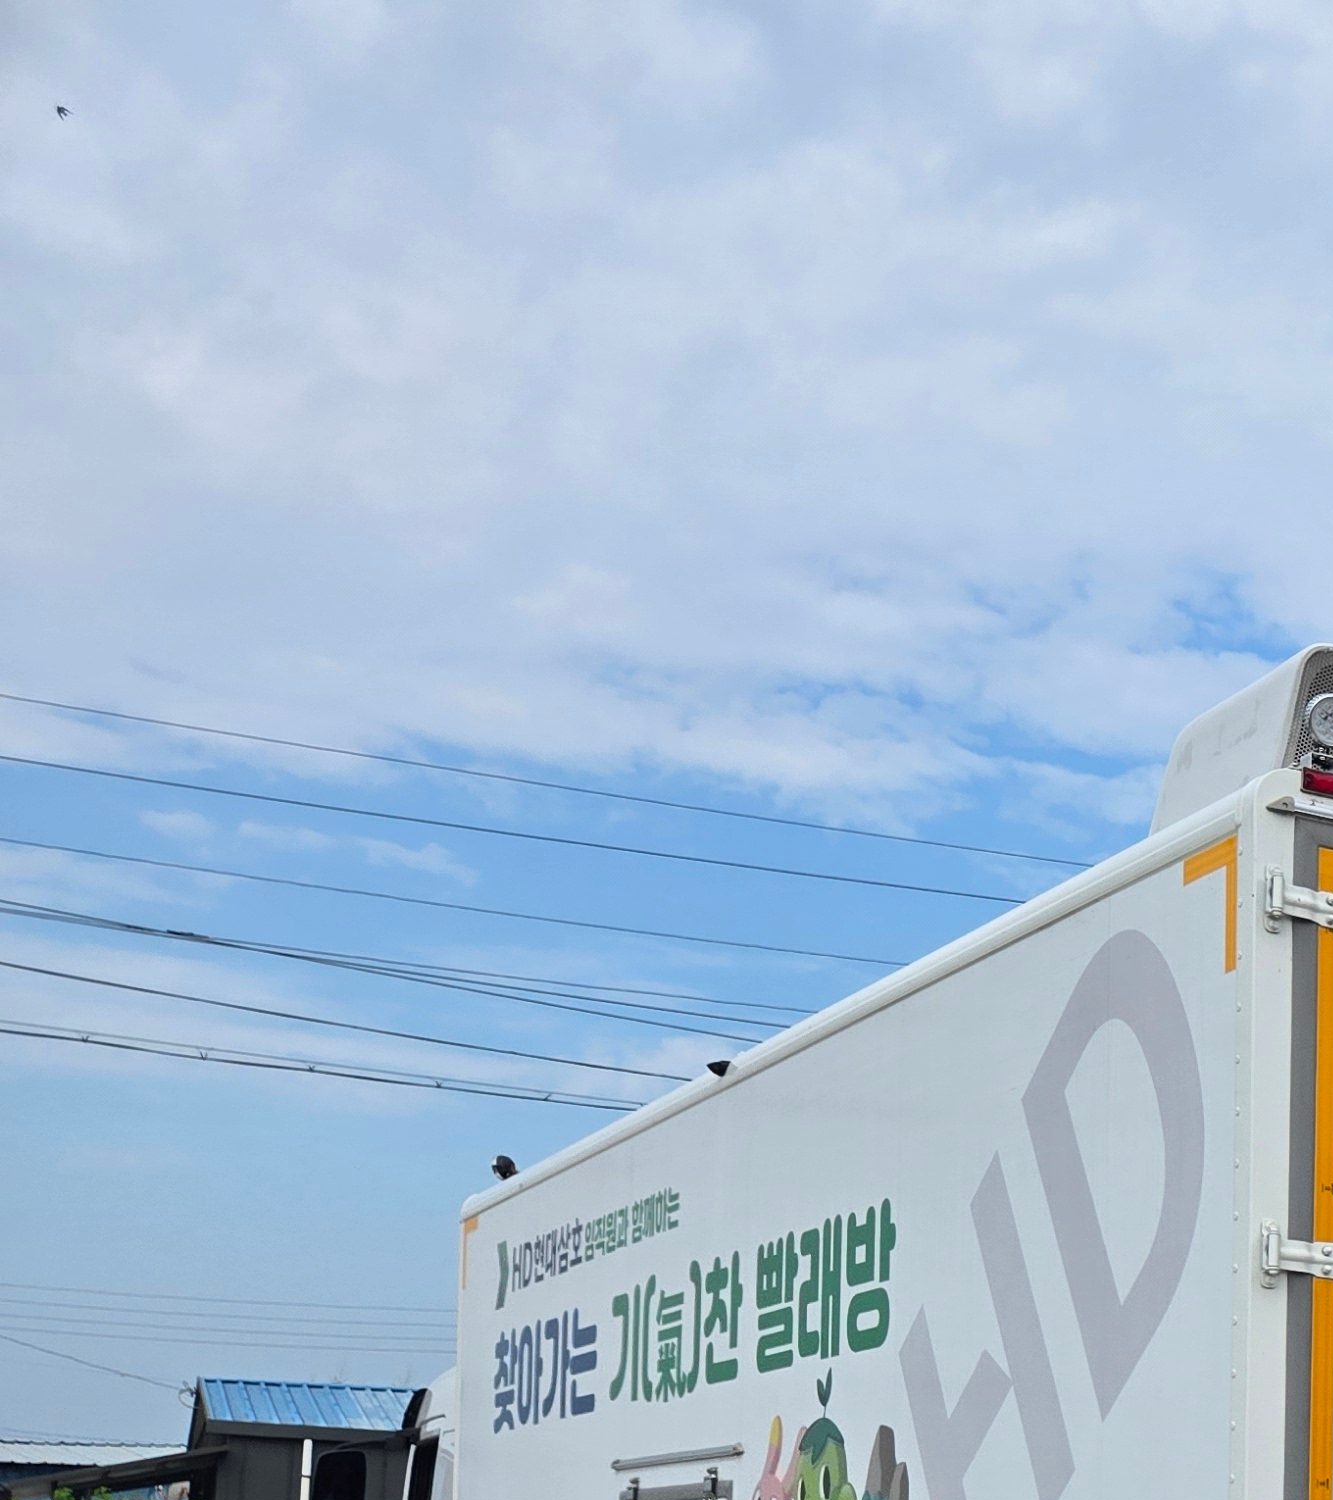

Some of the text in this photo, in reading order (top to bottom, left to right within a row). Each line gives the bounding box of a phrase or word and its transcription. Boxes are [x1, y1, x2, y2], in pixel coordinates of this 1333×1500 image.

[585, 1205, 629, 1262] 임직원과
[631, 1186, 680, 1244] 함께하는
[493, 1198, 896, 1434] 찾아가는 기(氣)찬 빨래방
